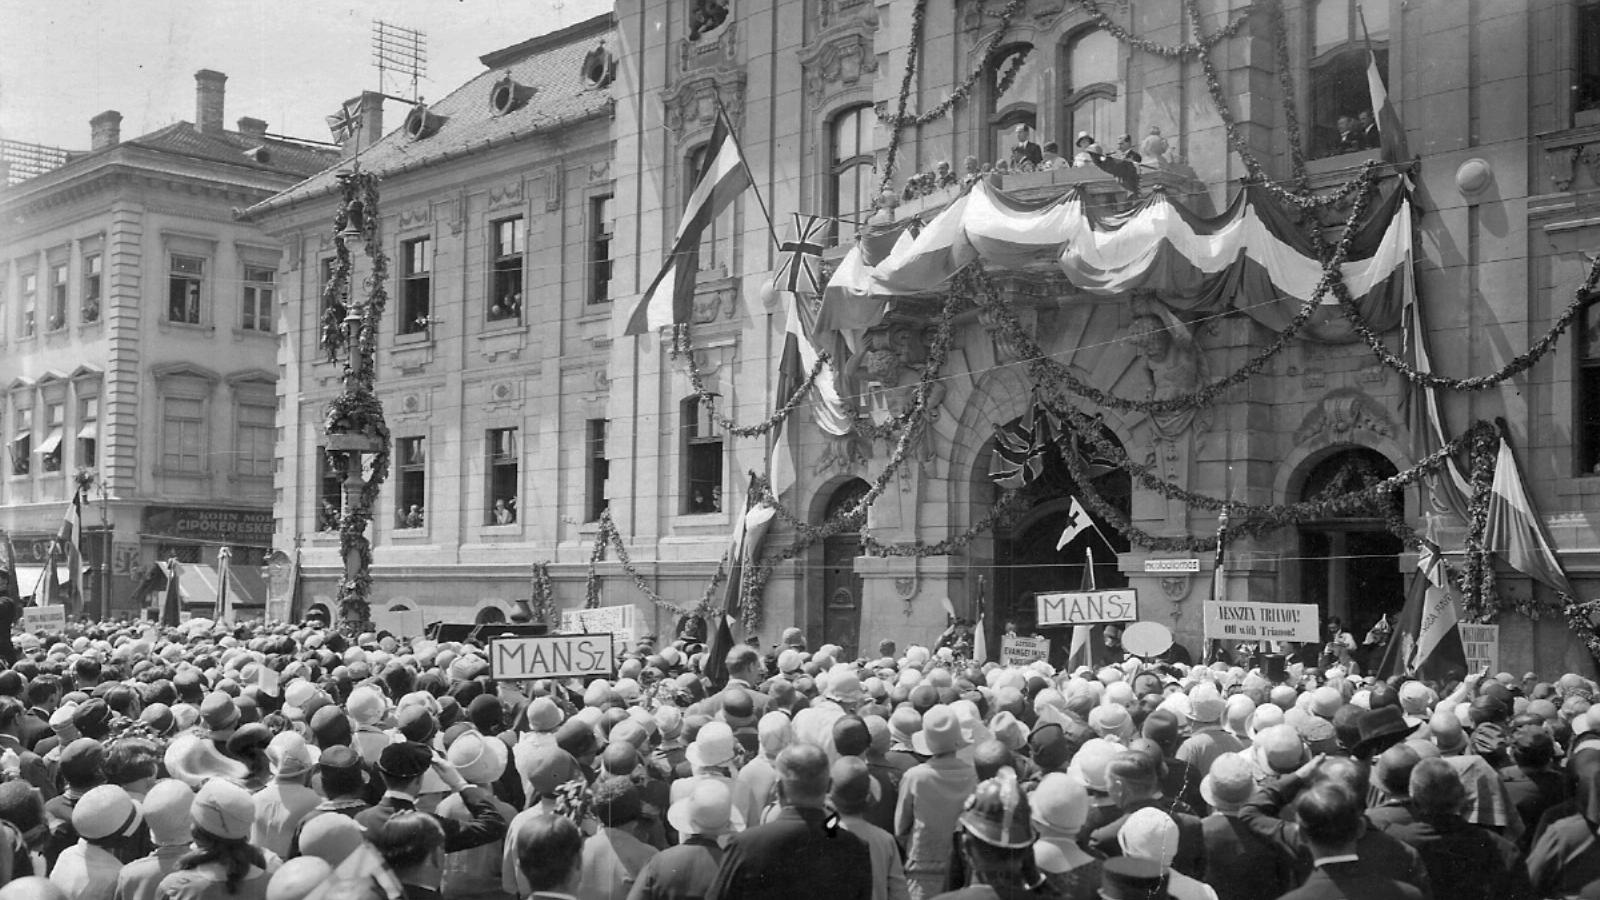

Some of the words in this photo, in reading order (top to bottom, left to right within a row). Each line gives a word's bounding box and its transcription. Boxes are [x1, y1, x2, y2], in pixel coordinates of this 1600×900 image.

[1260, 607, 1301, 624] TRIANON!
[1239, 625, 1257, 636] with
[1259, 626, 1296, 637] Trianon!
